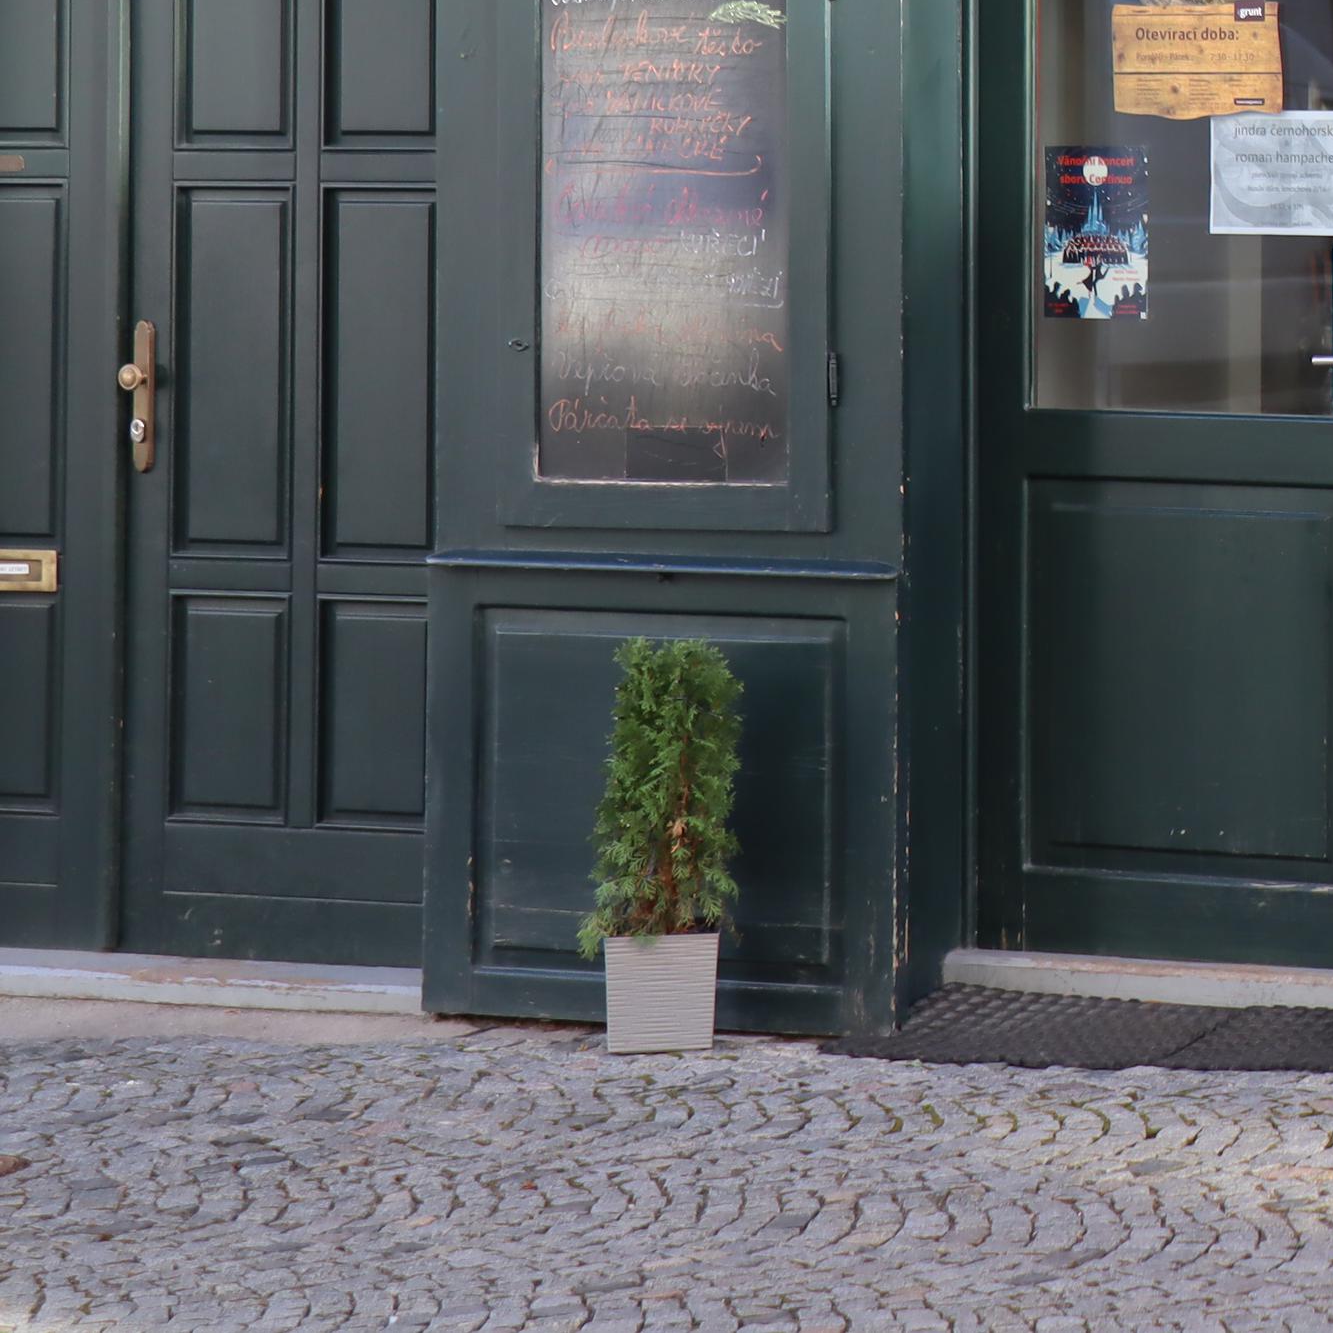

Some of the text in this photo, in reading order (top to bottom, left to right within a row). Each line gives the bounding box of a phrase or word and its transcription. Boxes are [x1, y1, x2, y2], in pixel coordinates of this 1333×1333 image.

[1237, 7, 1263, 19] grunt
[1135, 26, 1239, 42] Otevírací doba:
[1235, 153, 1272, 163] roman
